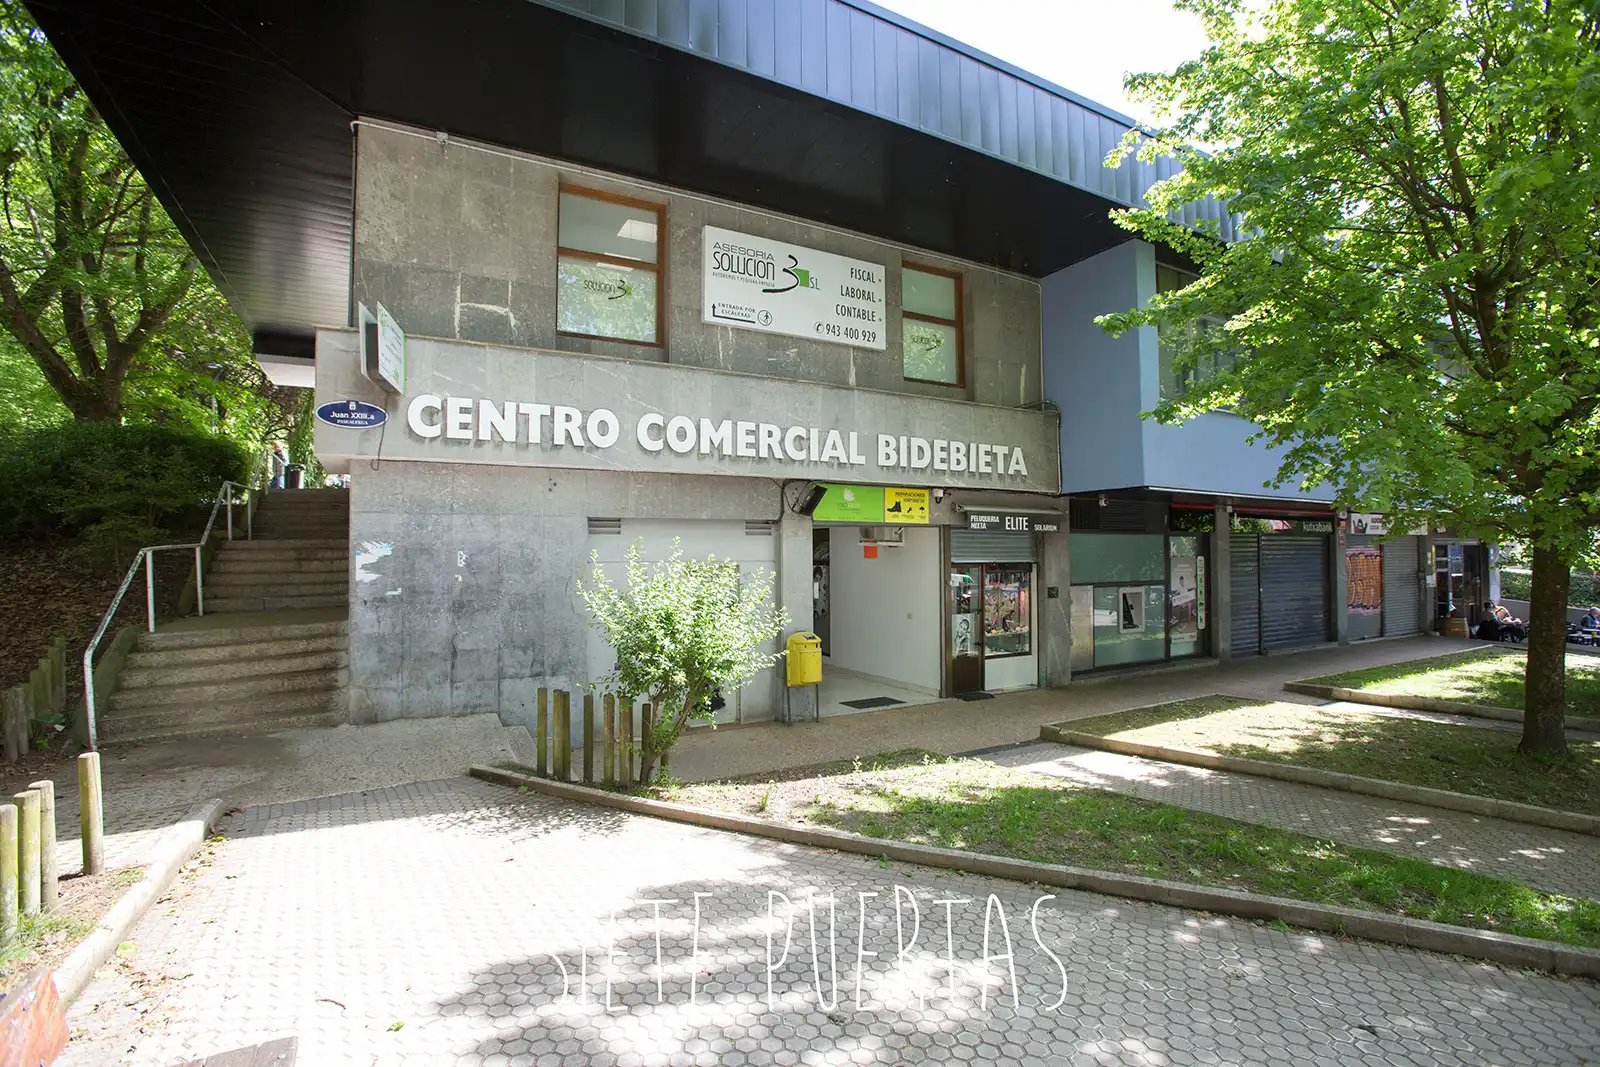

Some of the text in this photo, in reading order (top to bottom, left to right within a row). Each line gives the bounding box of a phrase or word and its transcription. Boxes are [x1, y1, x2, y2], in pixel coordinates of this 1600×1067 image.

[712, 242, 775, 261] ASESORIA
[850, 267, 876, 284] FISCAL
[840, 285, 876, 303] LABORAL
[718, 303, 744, 312] ENTRADA
[721, 309, 751, 318] ESCALERAS
[835, 303, 876, 322] CONTABLE
[825, 323, 876, 343] 943 400 929
[329, 411, 349, 419] Juan
[407, 393, 1029, 476] CENTRO COMERCIAL BIDEBIETA
[970, 514, 1000, 523] PELUQUERIA
[1004, 516, 1029, 531] ELITE
[970, 522, 987, 530] MIXTA
[1302, 521, 1333, 532] kutxabank
